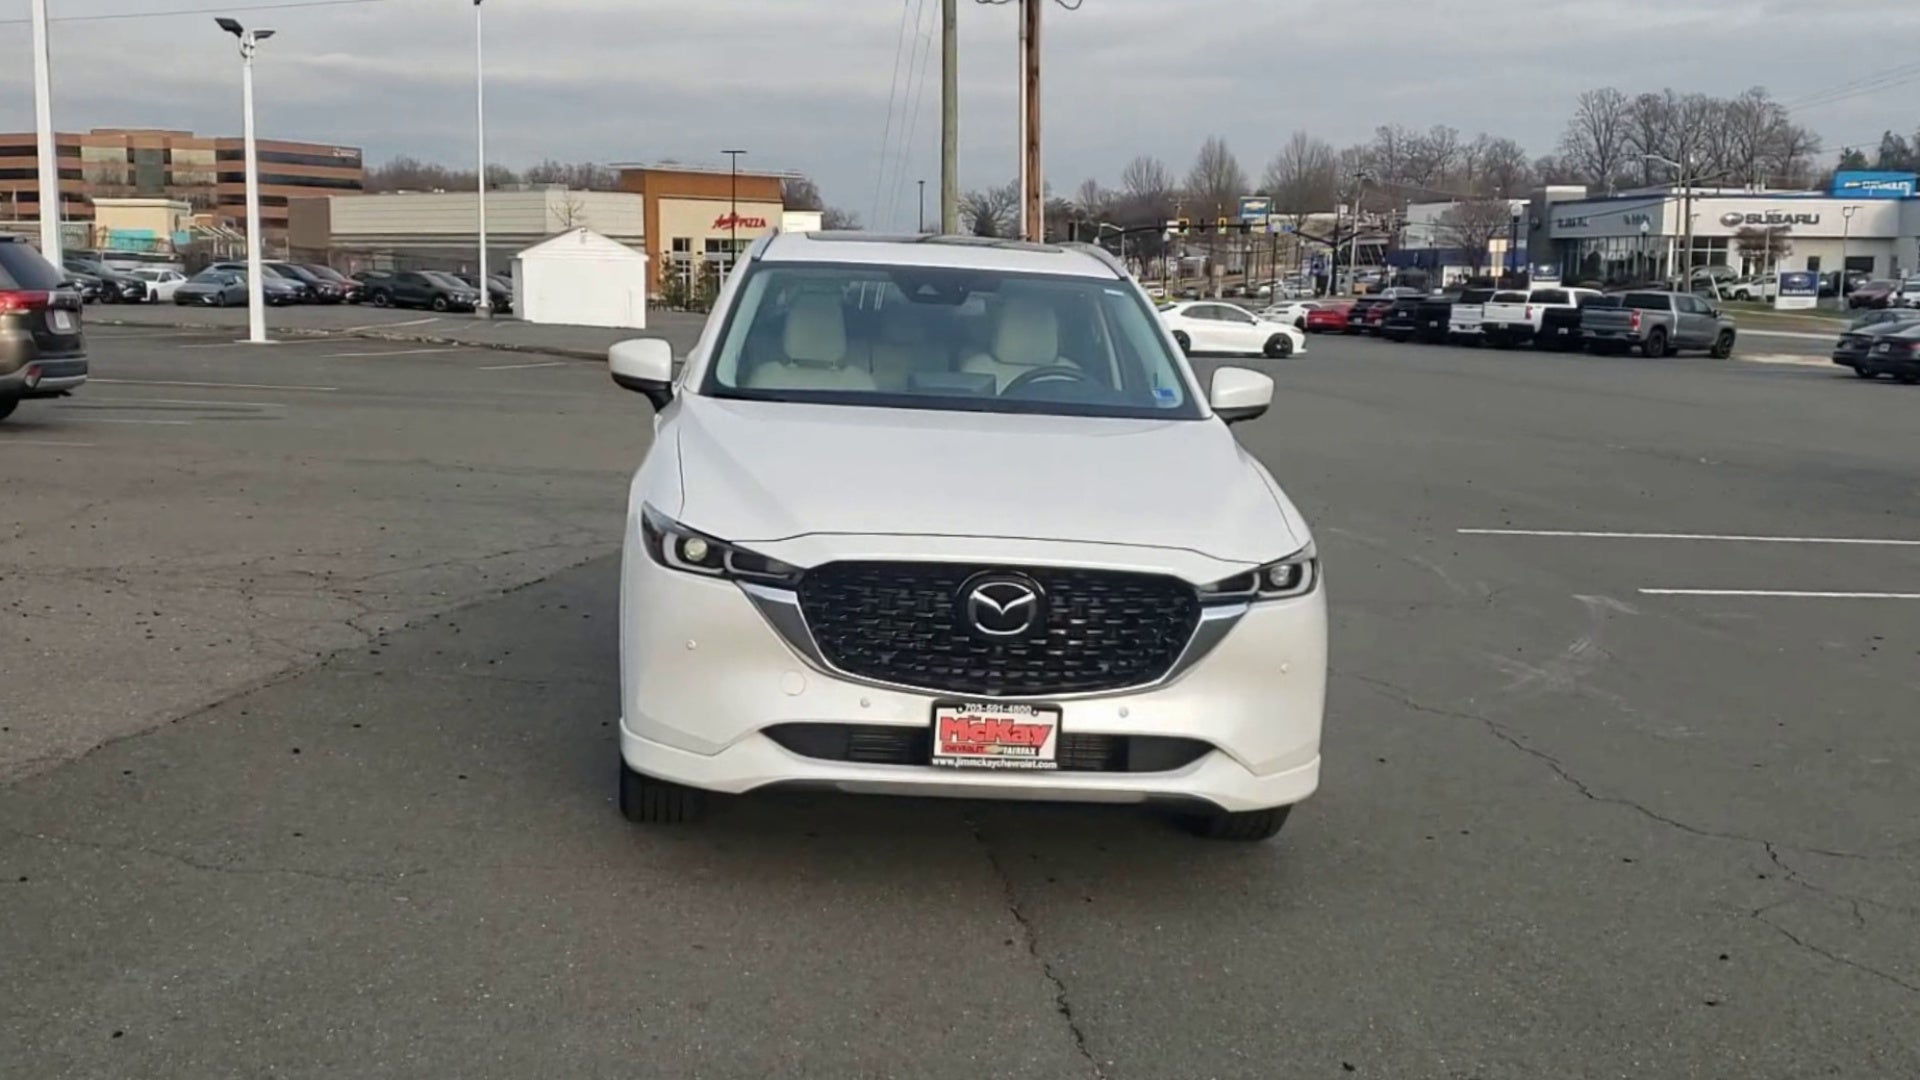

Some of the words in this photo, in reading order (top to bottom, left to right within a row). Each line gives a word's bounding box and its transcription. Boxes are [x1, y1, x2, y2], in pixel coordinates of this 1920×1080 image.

[739, 217, 767, 228] PIZZA
[1745, 213, 1819, 225] SUBARU
[940, 716, 1053, 748] McKay
[931, 757, 1057, 768] www.jimmckaychevrolet.com
